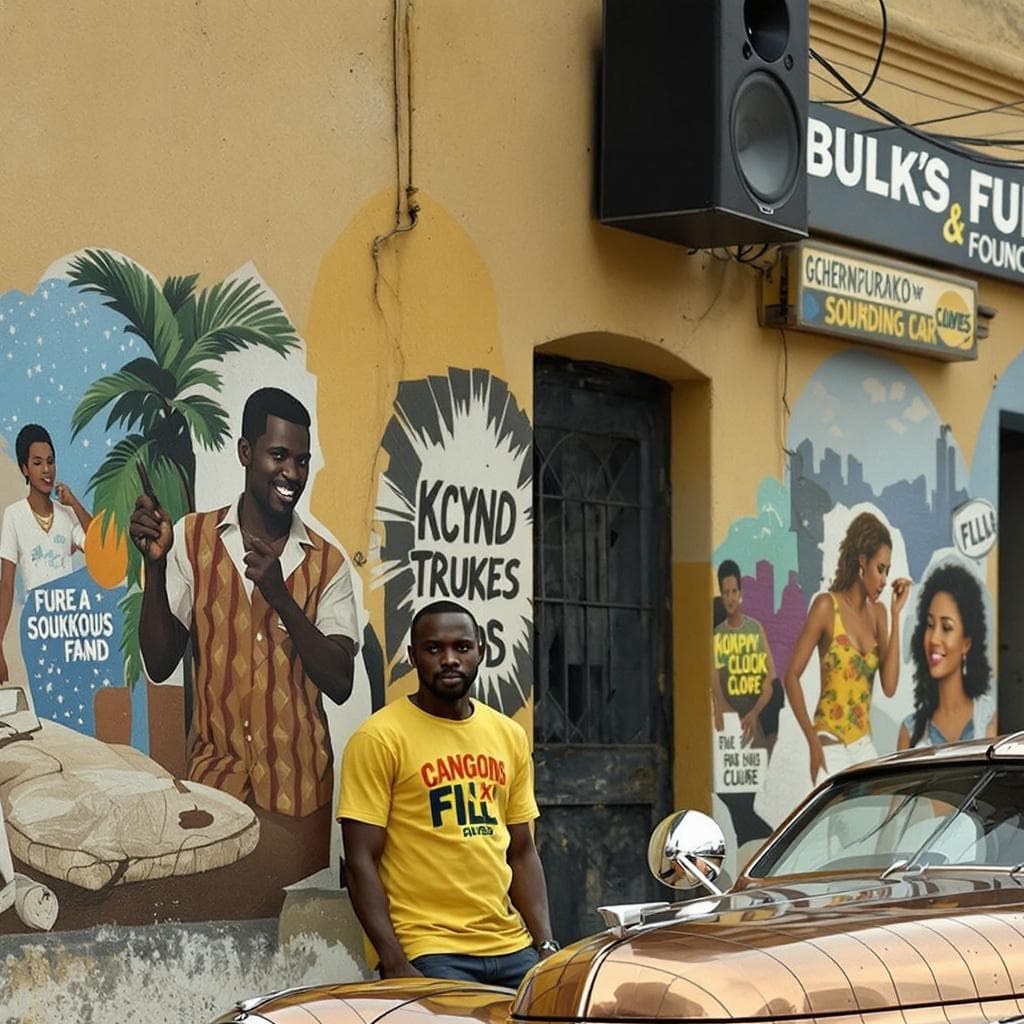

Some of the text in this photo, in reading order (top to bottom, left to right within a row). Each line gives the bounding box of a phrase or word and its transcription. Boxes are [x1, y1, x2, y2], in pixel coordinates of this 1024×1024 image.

[806, 117, 951, 214] BULK'S
[942, 203, 965, 245] &
[417, 479, 517, 546] KCYND
[34, 588, 91, 613] FURE A
[410, 550, 521, 601] TRUKES
[64, 639, 110, 663] FAND
